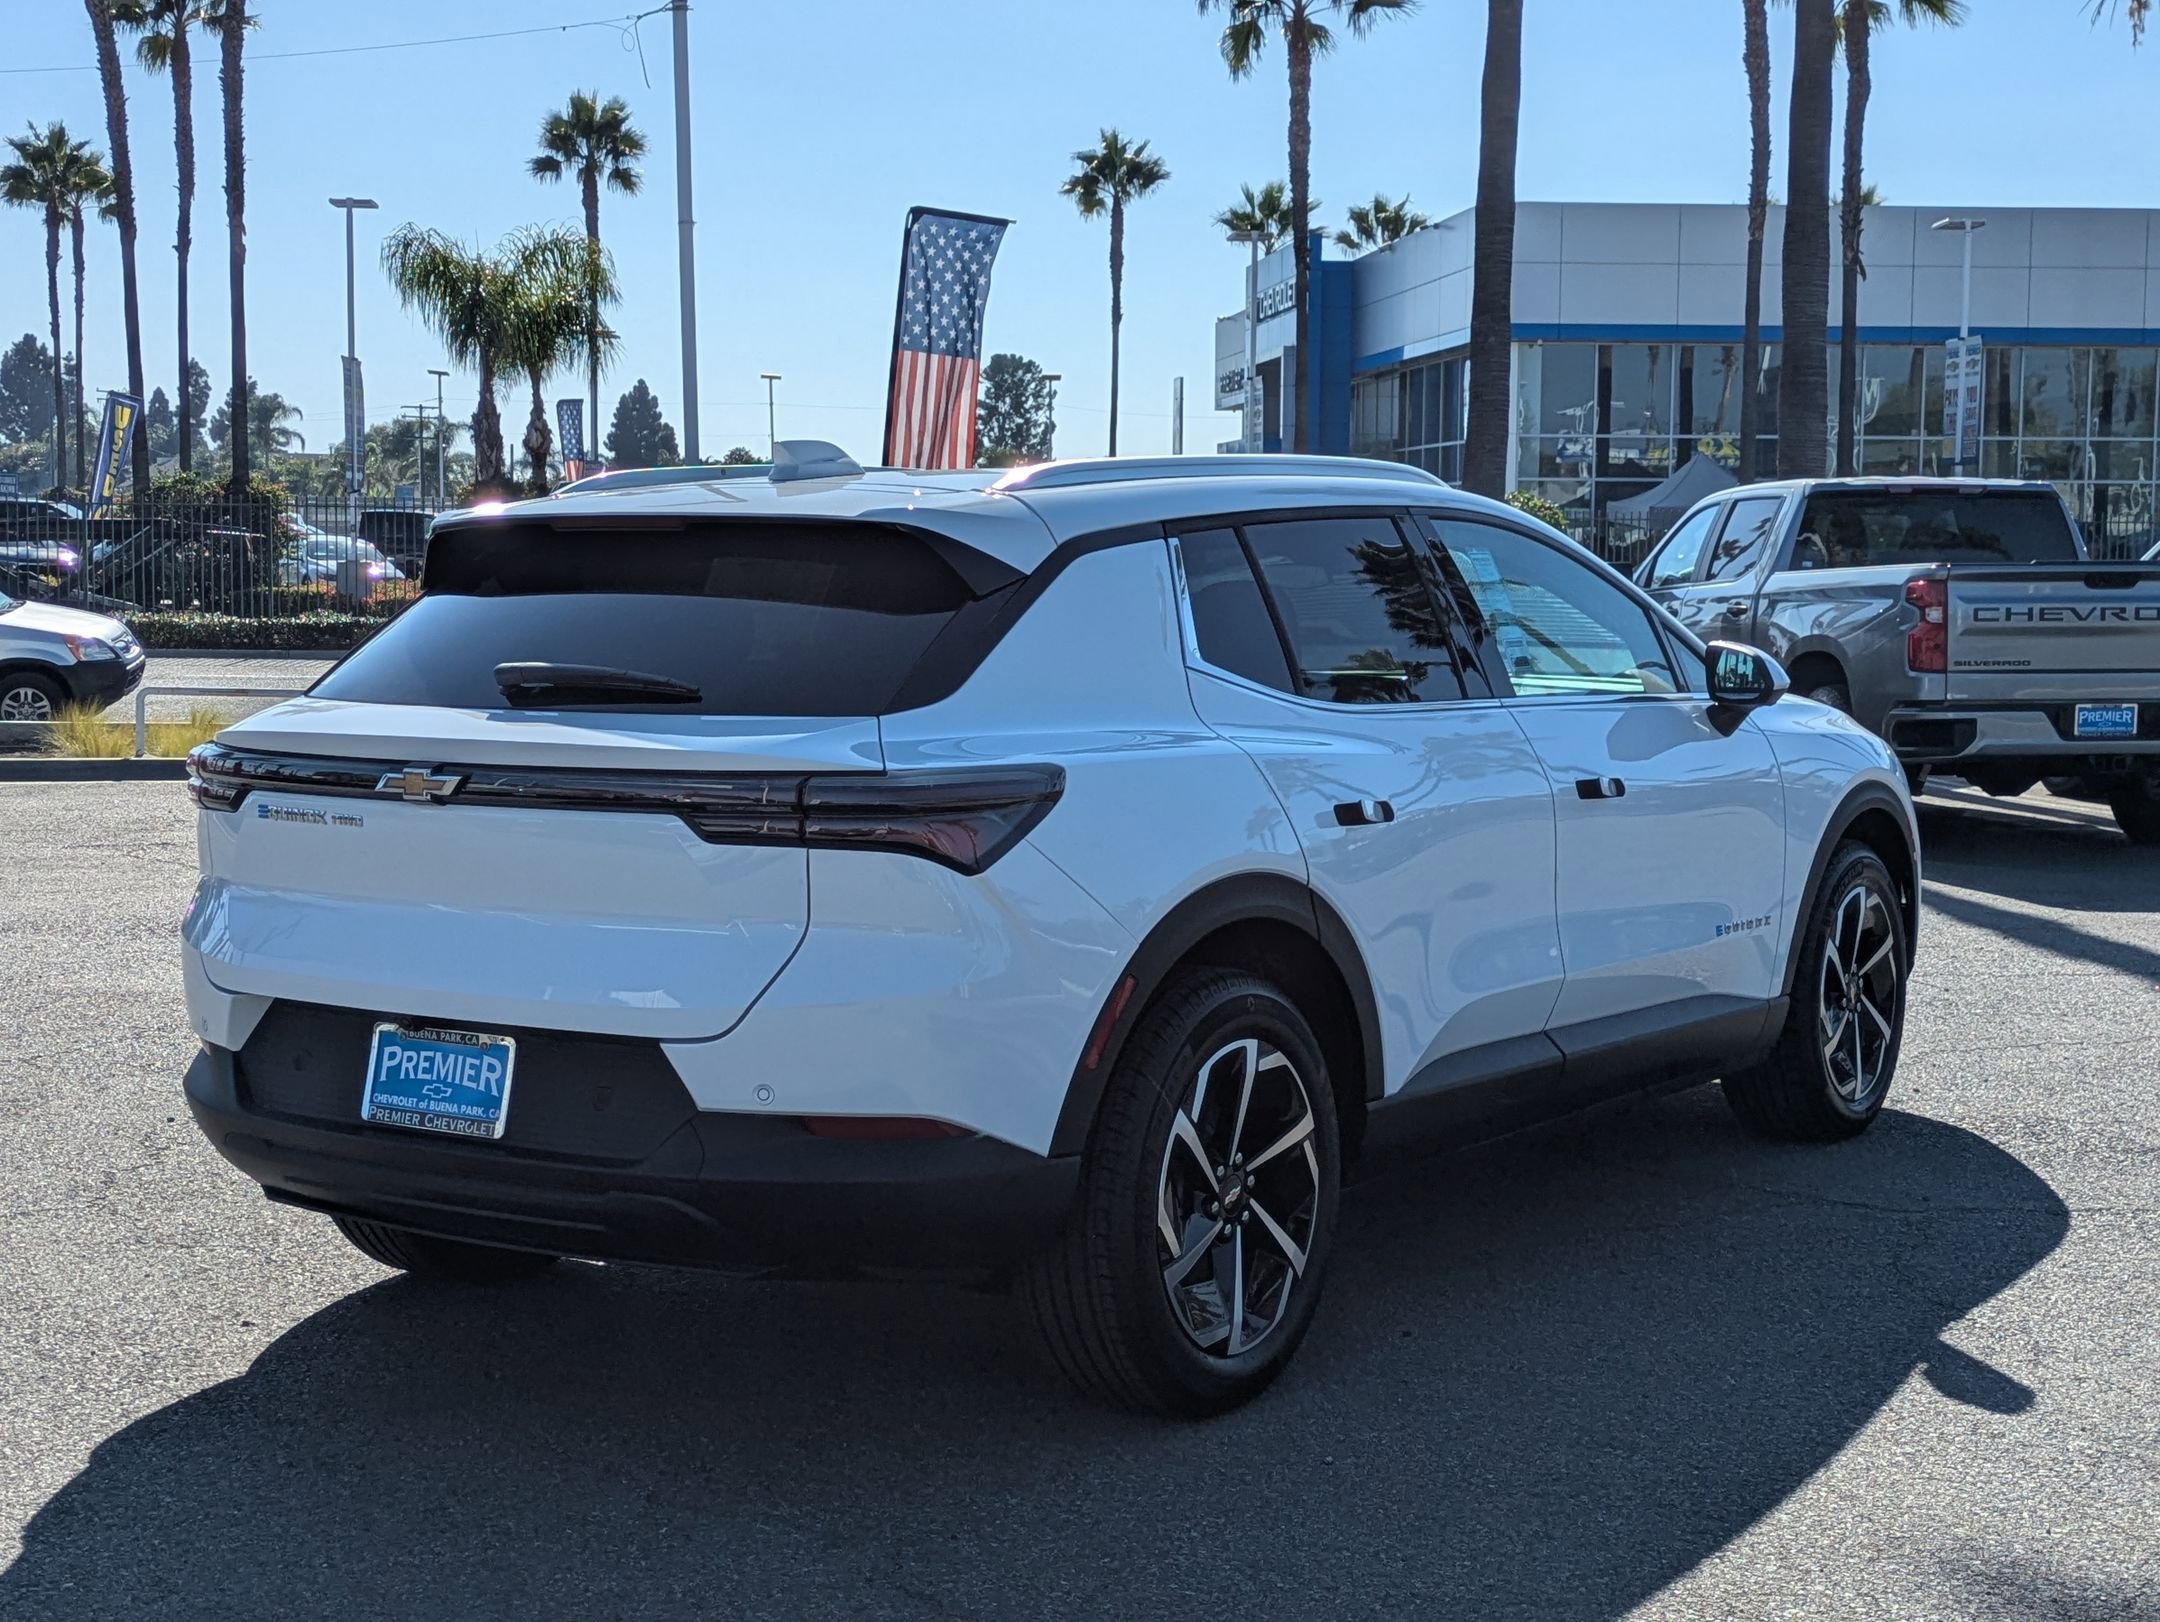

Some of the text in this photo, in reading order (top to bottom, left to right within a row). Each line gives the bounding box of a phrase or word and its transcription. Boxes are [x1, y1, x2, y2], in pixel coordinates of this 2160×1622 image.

[103, 405, 131, 497] USED
[2079, 710, 2132, 724] PREMIER
[409, 1029, 438, 1041] BUENA
[379, 1046, 502, 1097] PREMIER
[373, 1093, 417, 1108] CHEVROLET
[418, 1099, 428, 1109] of
[429, 1103, 459, 1114] BUENA
[367, 1105, 497, 1136] PREMIER CHEVROLET
